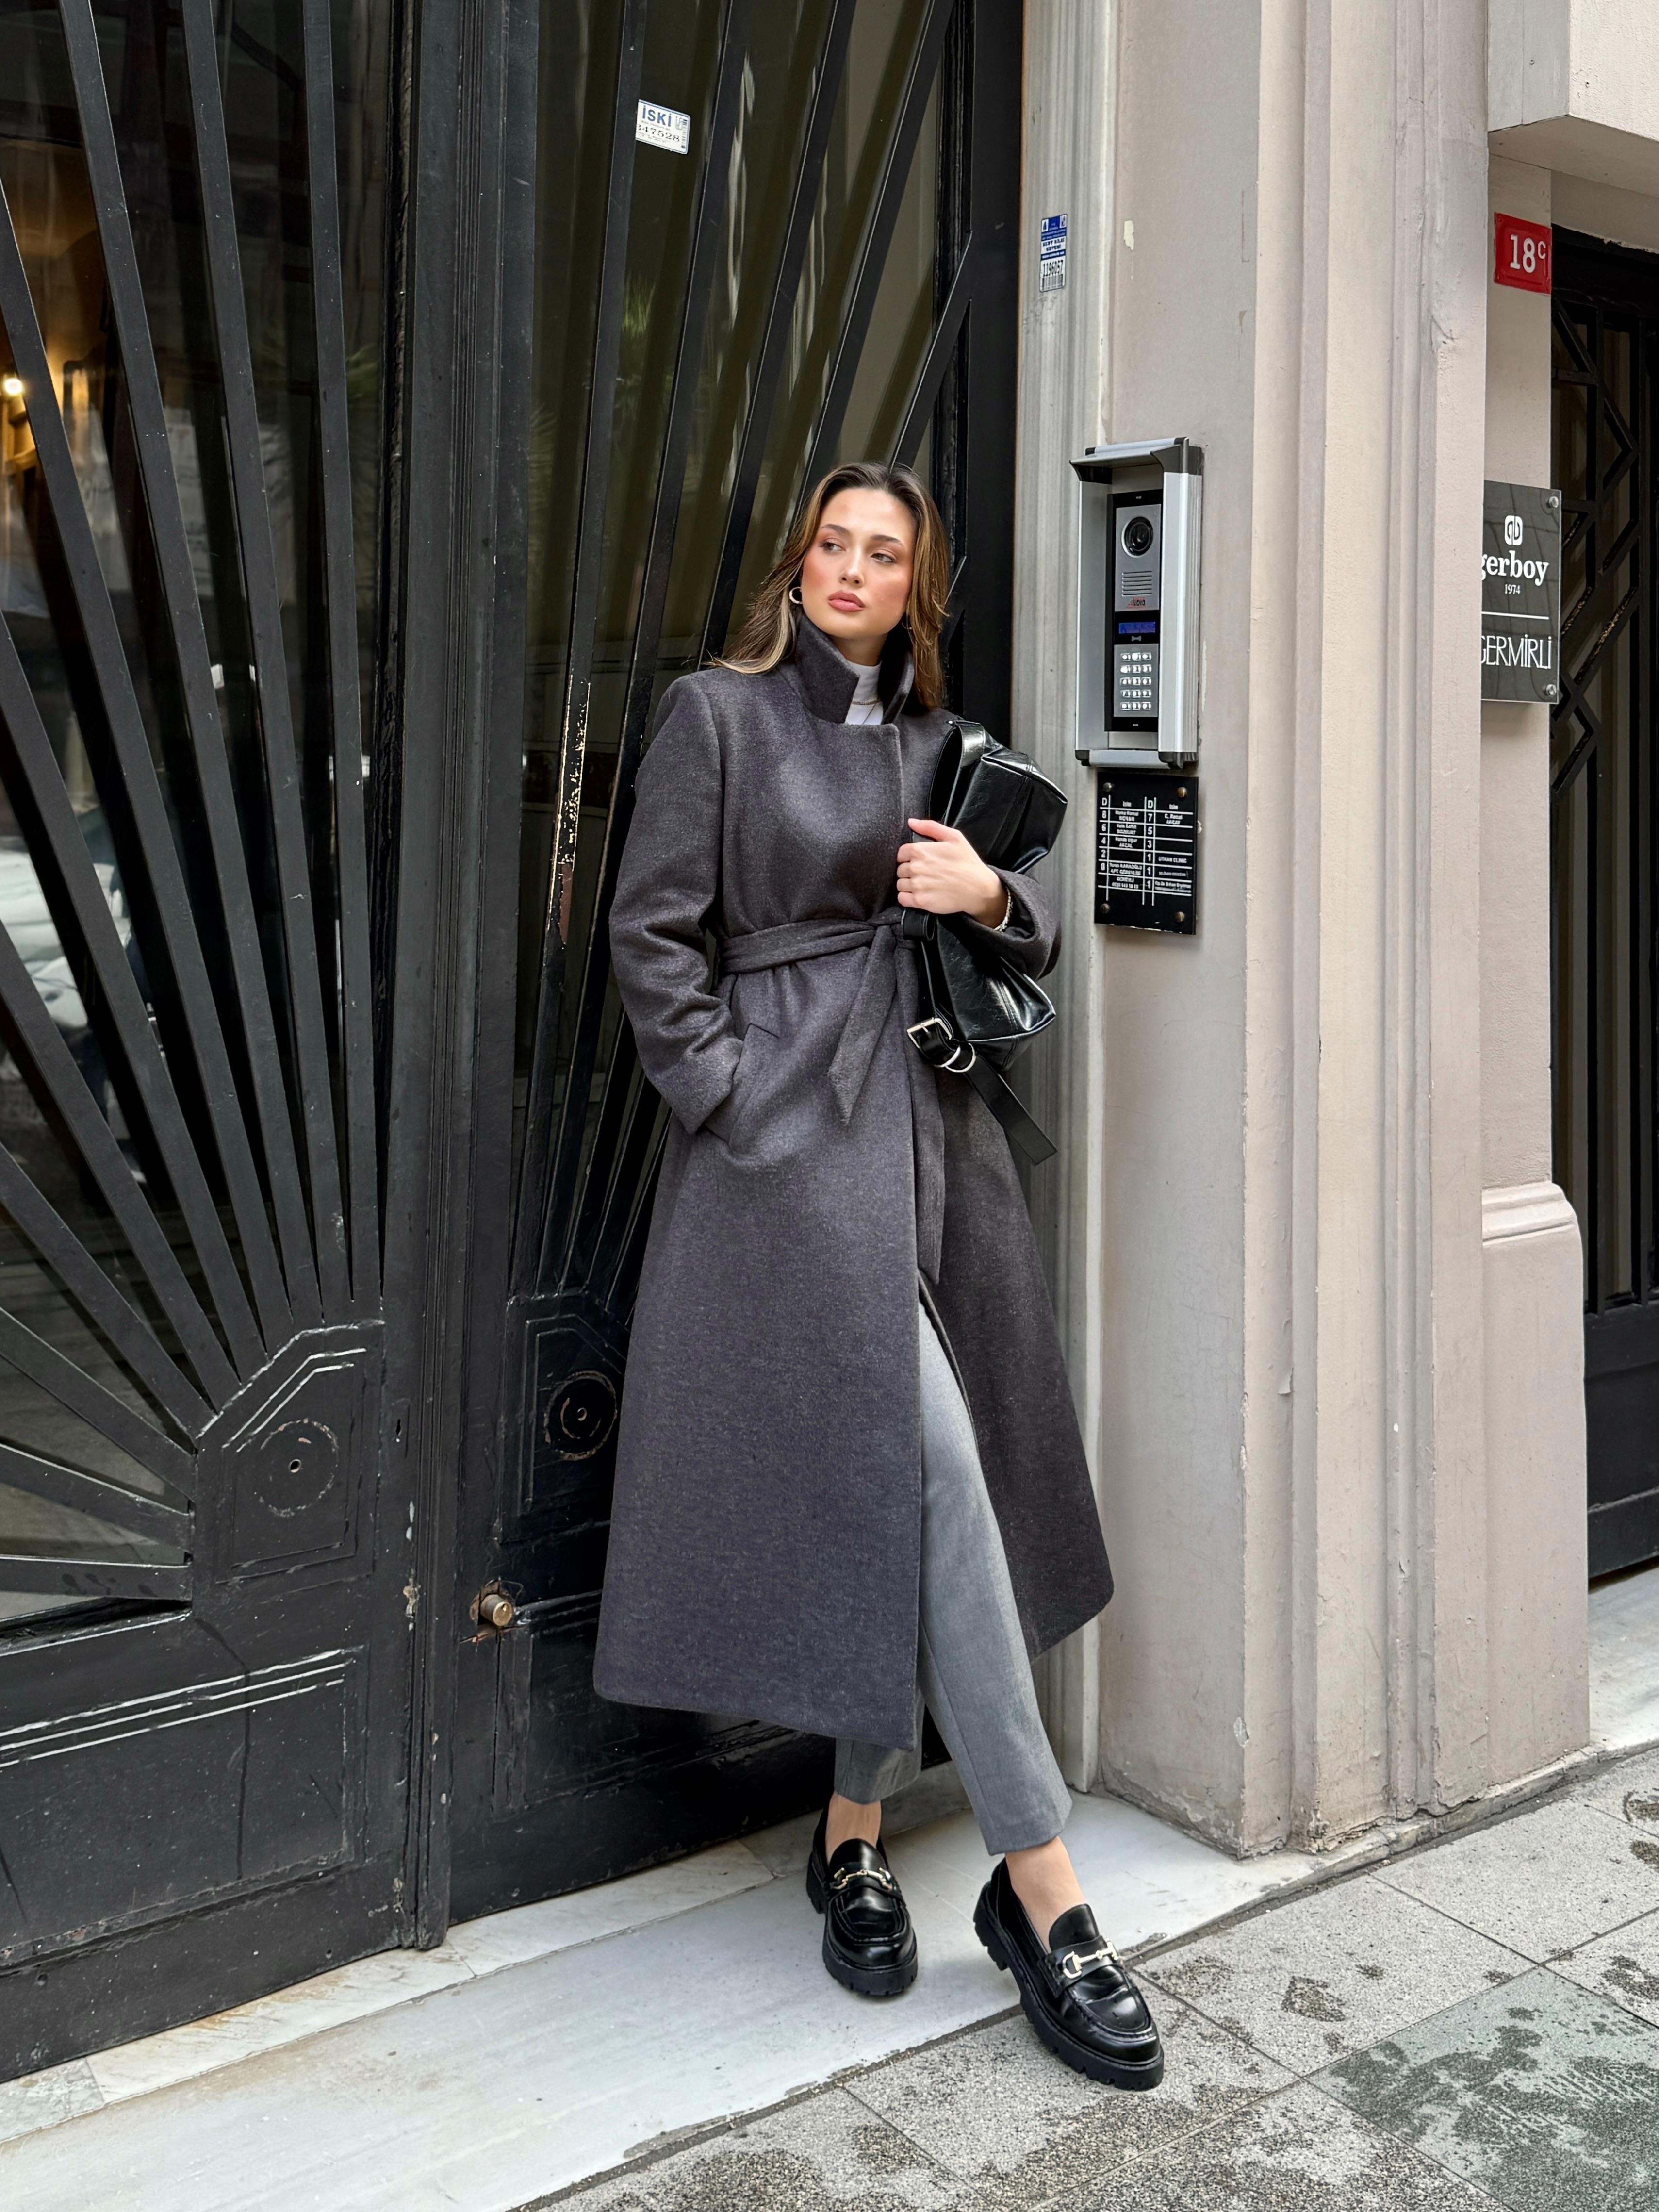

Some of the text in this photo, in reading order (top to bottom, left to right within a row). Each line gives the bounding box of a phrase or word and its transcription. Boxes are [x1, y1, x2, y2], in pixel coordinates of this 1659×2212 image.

[642, 105, 672, 127] İSKİ
[1505, 584, 1521, 595] 1974
[1102, 797, 1107, 806] D
[1148, 800, 1153, 809] D
[1102, 810, 1107, 819] 8
[1148, 813, 1153, 822] 7
[1101, 824, 1106, 832] 6
[1147, 826, 1152, 835] 5
[1147, 840, 1152, 848] 3
[1101, 849, 1106, 858] 2
[1147, 853, 1151, 861] 1
[1147, 867, 1151, 875] 1
[1147, 880, 1151, 889] 1
